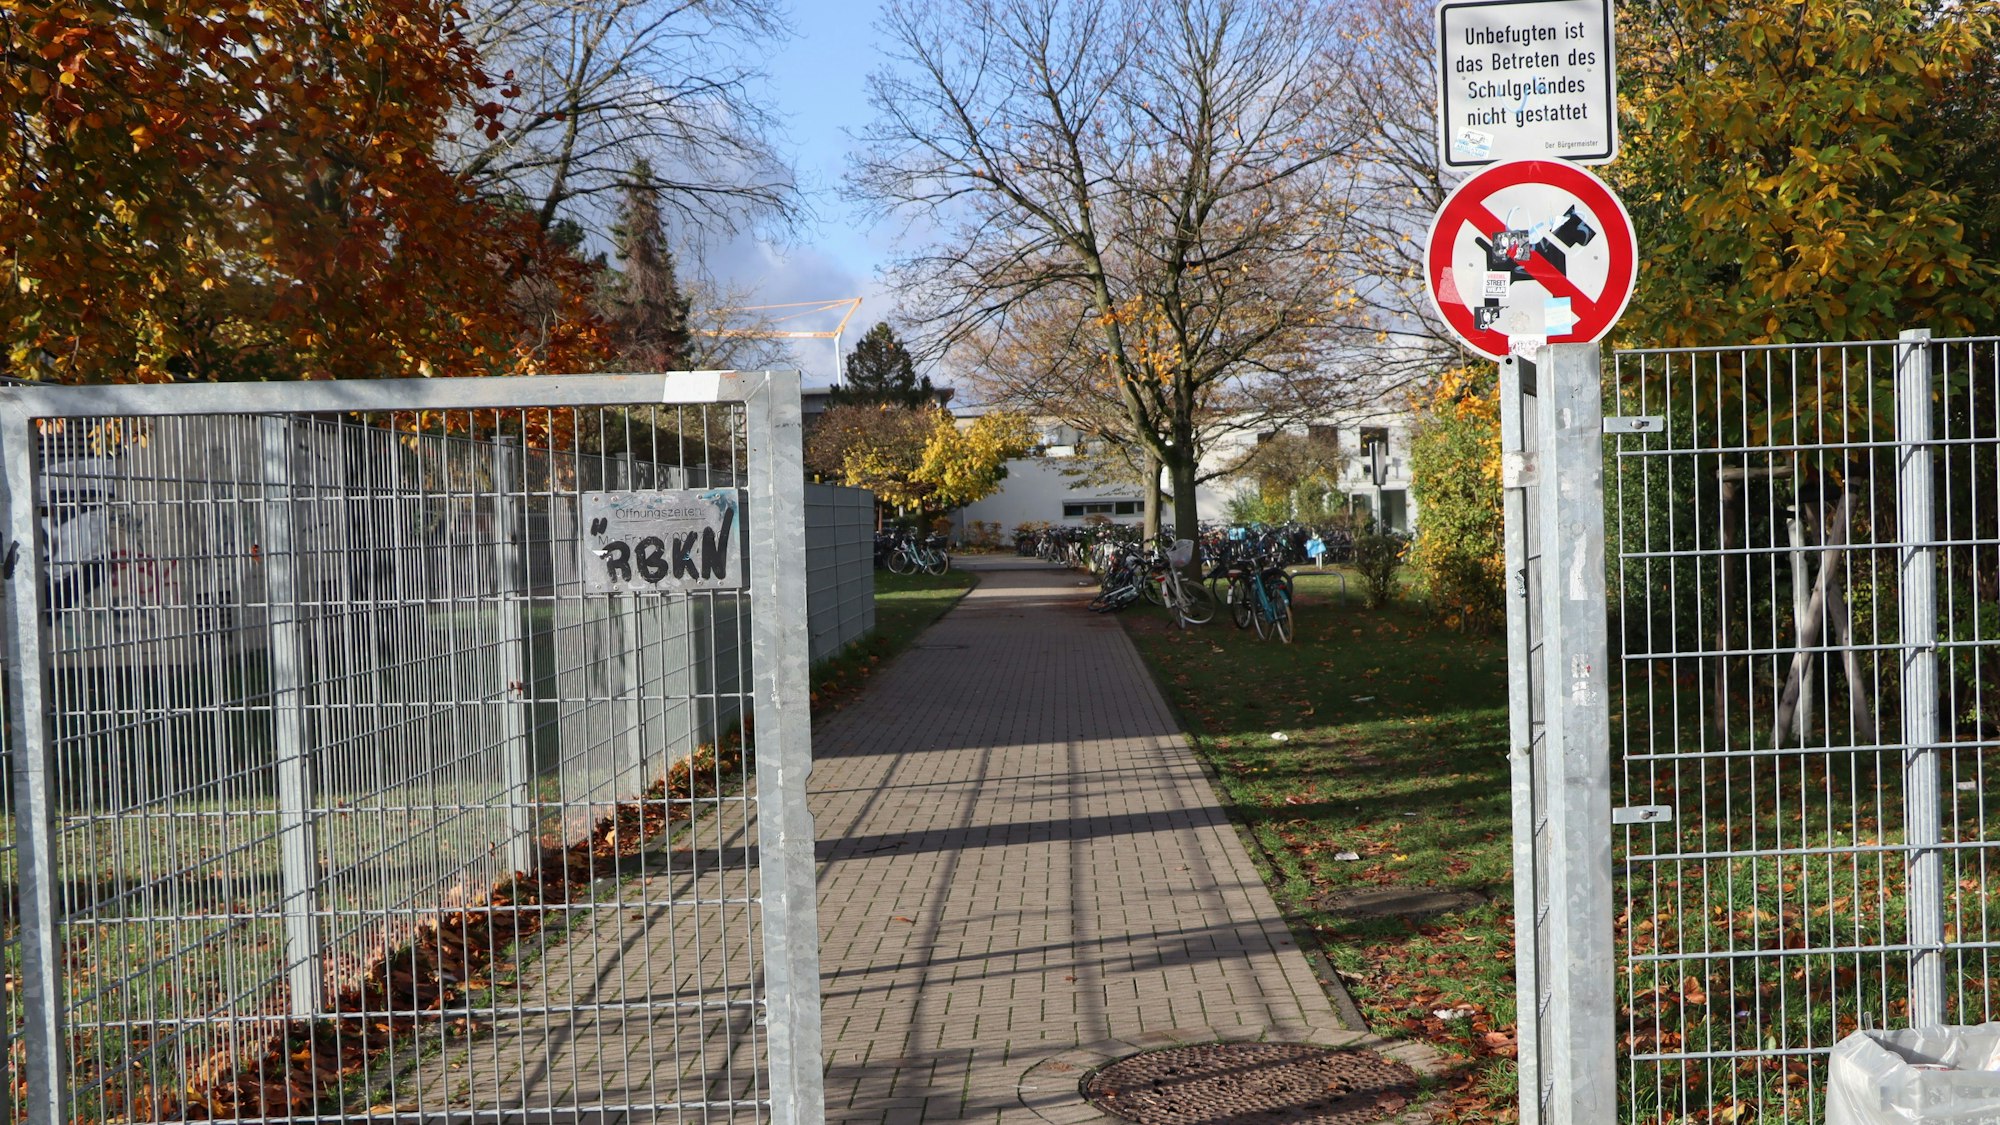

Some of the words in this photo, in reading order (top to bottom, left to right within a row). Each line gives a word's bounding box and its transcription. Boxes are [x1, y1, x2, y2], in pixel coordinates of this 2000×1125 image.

[1465, 24, 1557, 47] Unbefugten
[1565, 21, 1585, 40] ist
[1456, 55, 1483, 73] das
[1492, 51, 1559, 71] Betreten
[1568, 48, 1596, 66] des
[1468, 75, 1585, 101] Schulgeländes
[1467, 107, 1507, 126] nicht
[1516, 103, 1588, 128] gestattet
[1545, 141, 1555, 149] Der
[1557, 140, 1598, 149] Bürgermeister
